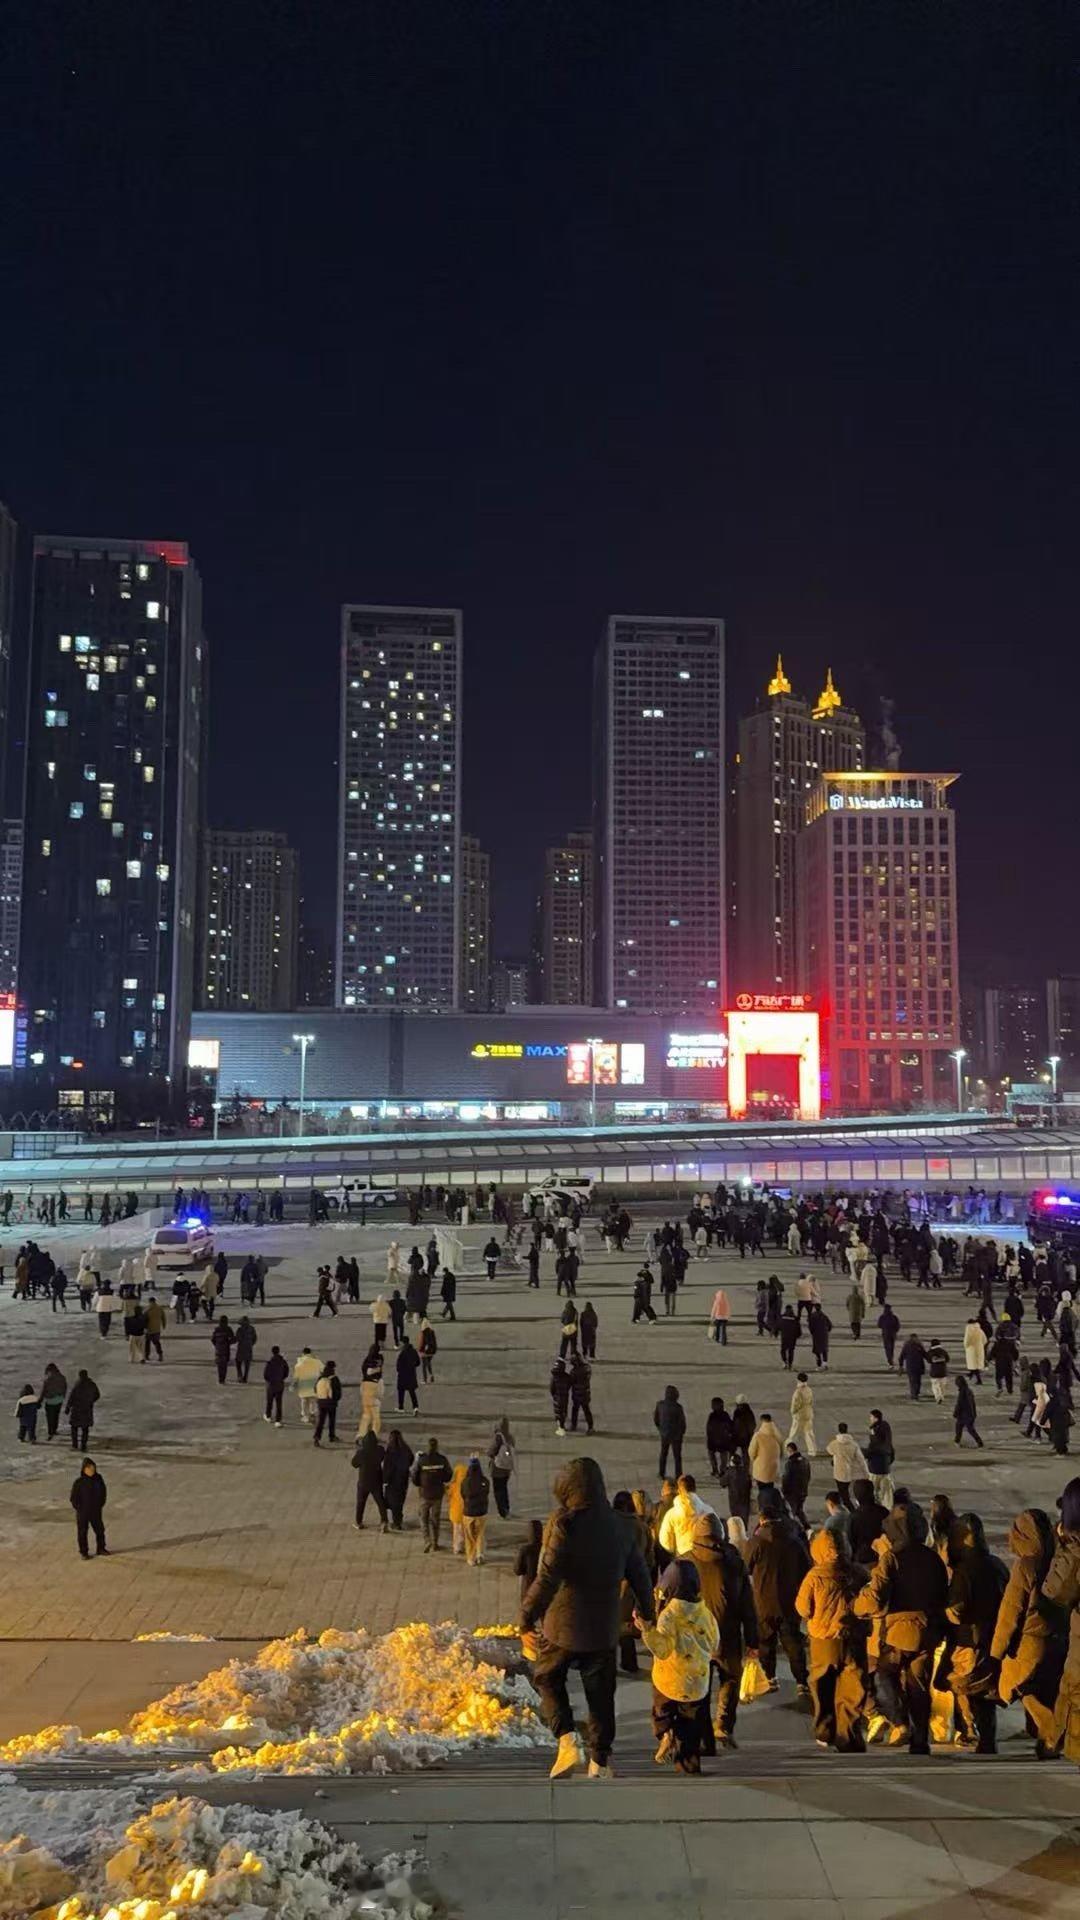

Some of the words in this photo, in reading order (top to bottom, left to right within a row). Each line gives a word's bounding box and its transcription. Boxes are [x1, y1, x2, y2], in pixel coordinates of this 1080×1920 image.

[754, 995, 804, 1006] 万达广场
[527, 1045, 566, 1056] MAX
